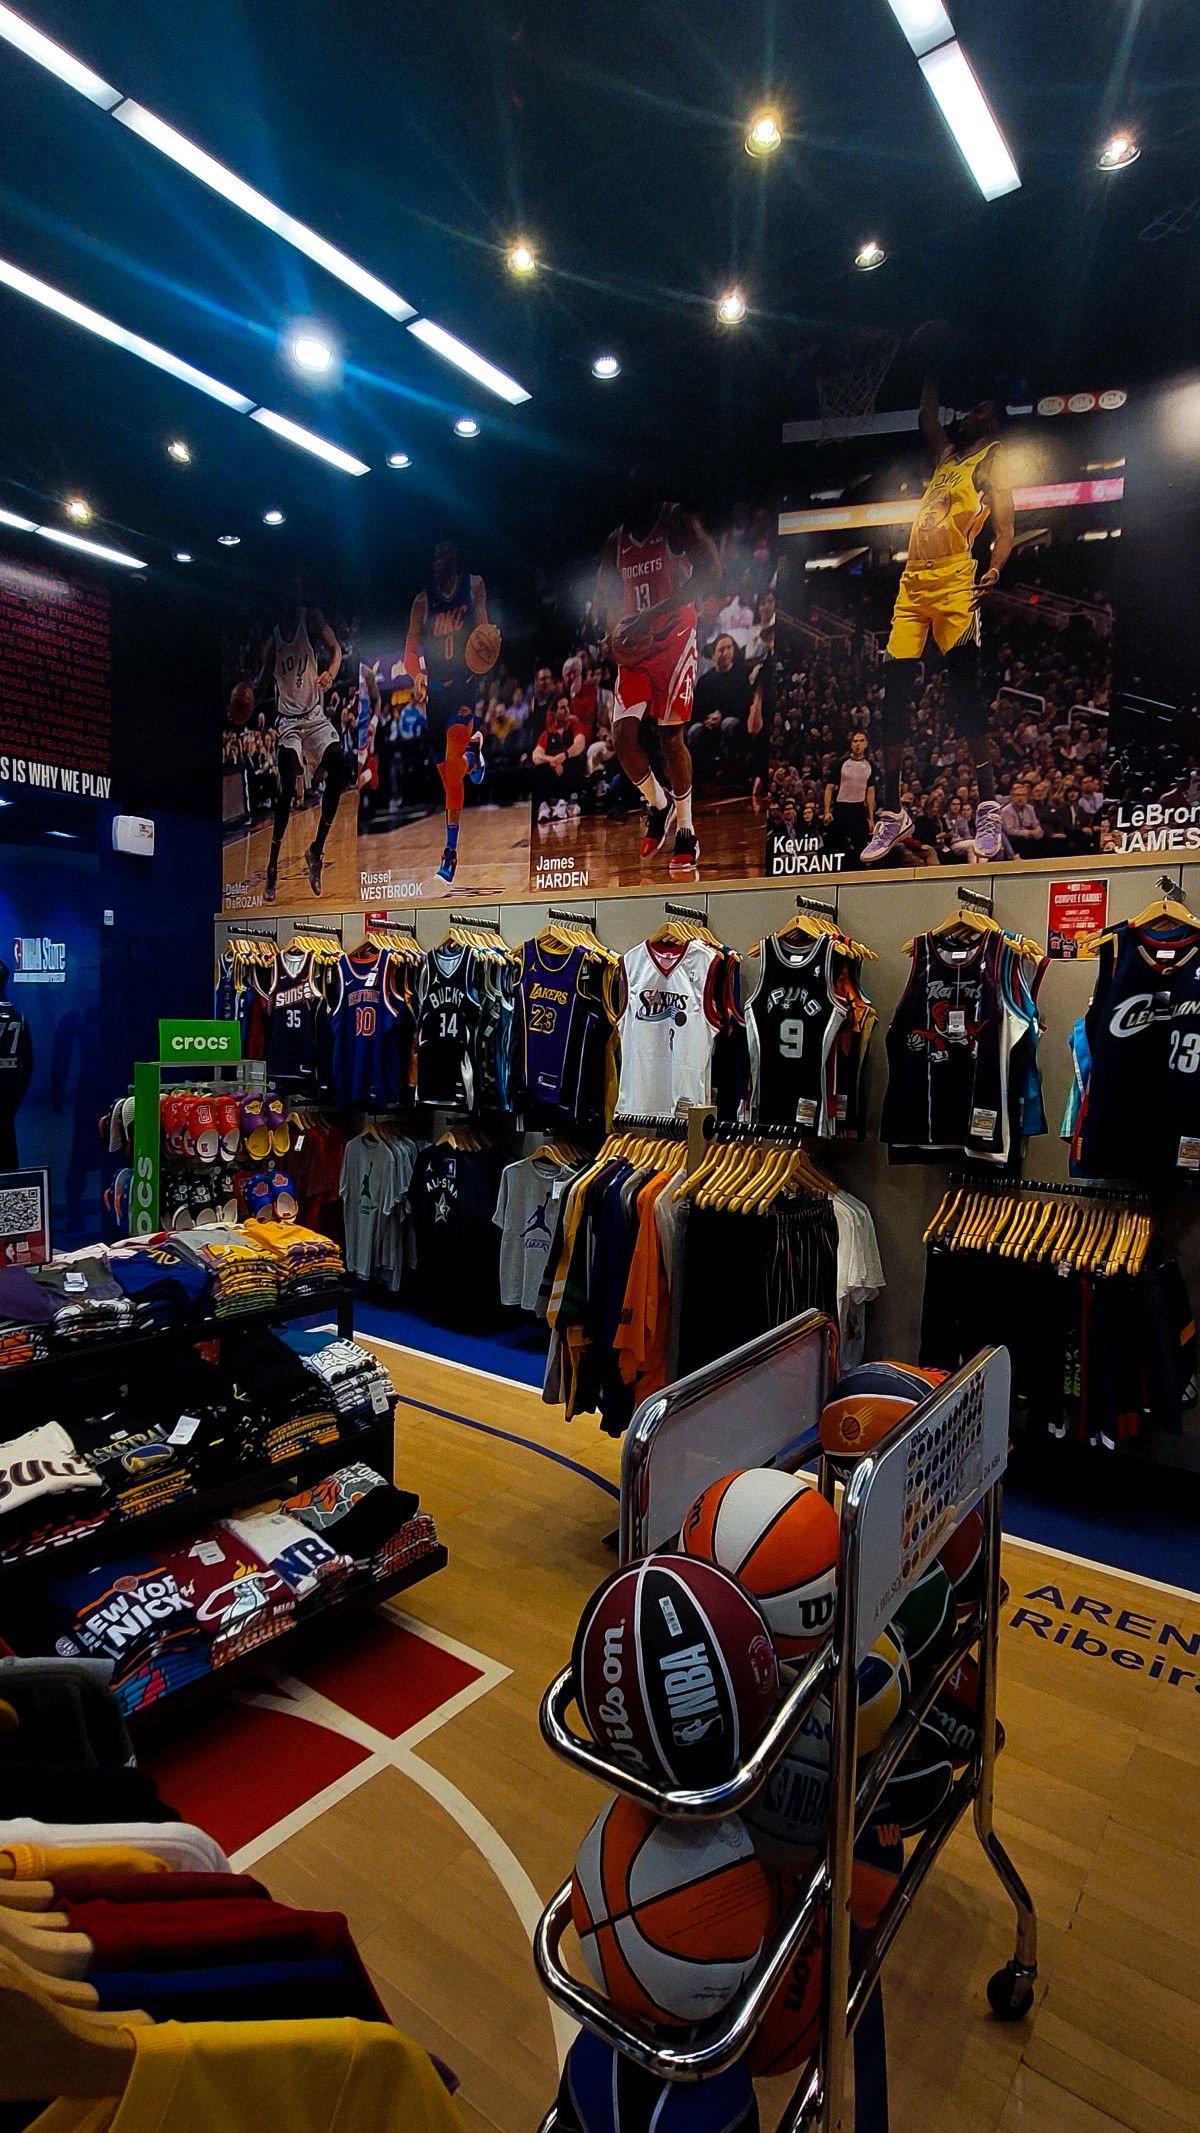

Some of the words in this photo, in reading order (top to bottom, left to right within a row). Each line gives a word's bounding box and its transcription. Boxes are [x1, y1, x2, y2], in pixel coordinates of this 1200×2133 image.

[622, 557, 663, 579] ROCKETS
[634, 583, 651, 613] 13
[12, 758, 27, 784] IS
[28, 761, 59, 790] WHY
[60, 767, 80, 794] WE
[81, 772, 112, 799] PLAY
[773, 833, 819, 855] Kevin
[1114, 827, 1200, 855] JAMES
[536, 855, 575, 872] James
[772, 852, 846, 875] DURANT
[225, 882, 249, 896] DeMar
[360, 869, 392, 886] Russel
[535, 871, 589, 890] HARDEN
[225, 895, 263, 909] DeROZAN
[360, 882, 423, 900] WESTBROOK
[429, 986, 465, 1009] BUCKS
[529, 983, 569, 1005] LAKERS
[766, 986, 823, 1017] SPURS
[285, 1009, 302, 1029] 35
[438, 1012, 459, 1038] 34
[529, 1003, 557, 1035] 23
[171, 1035, 229, 1050] crocs
[779, 1018, 804, 1059] 9
[1168, 1029, 1200, 1074] 23
[1023, 1584, 1200, 1656] AREN
[658, 1642, 720, 1719] NBA
